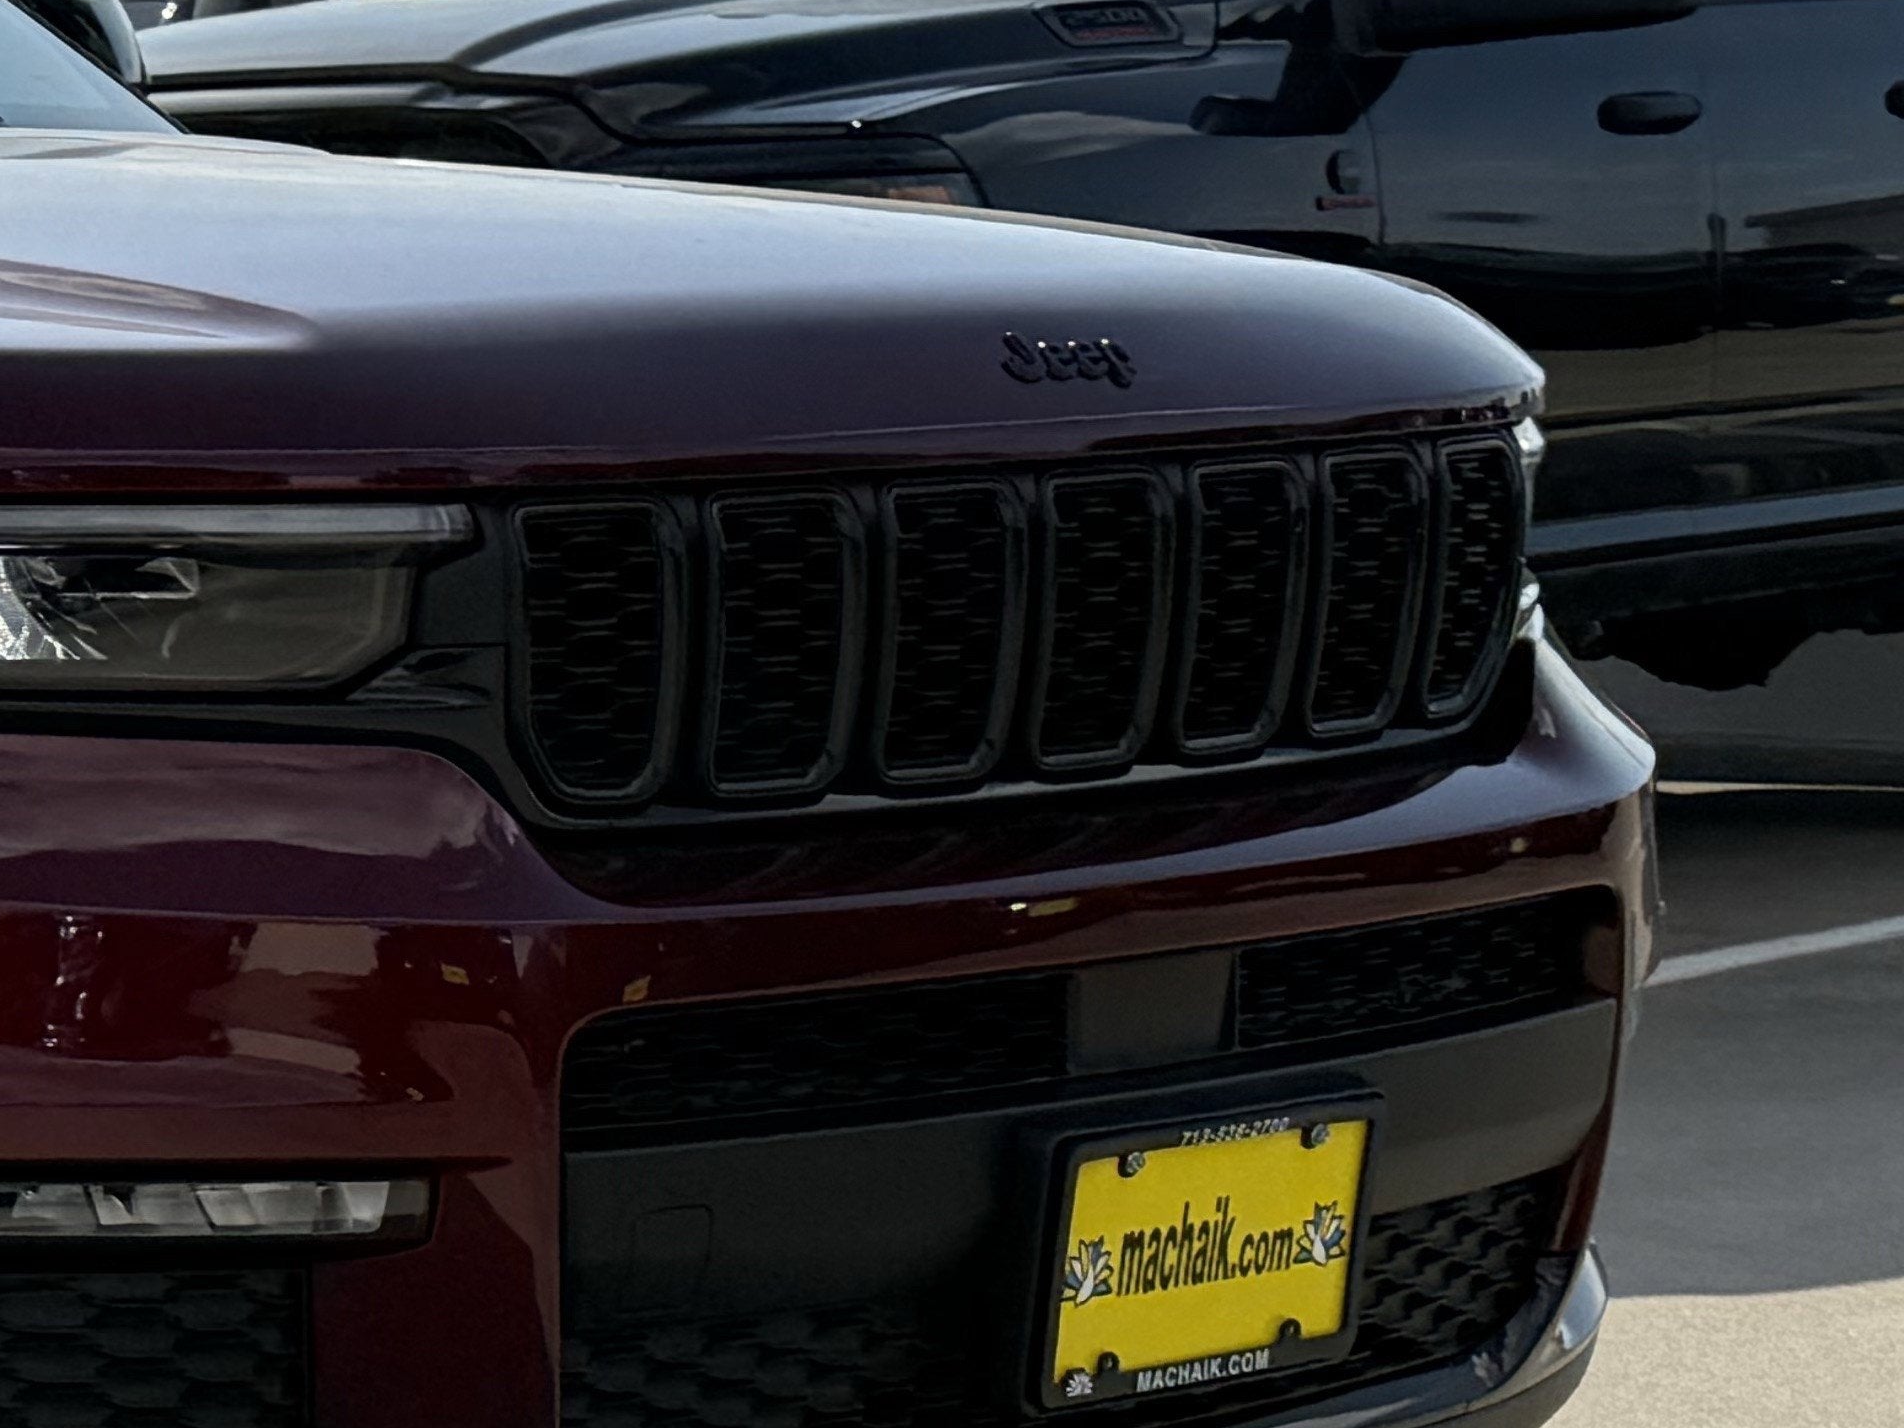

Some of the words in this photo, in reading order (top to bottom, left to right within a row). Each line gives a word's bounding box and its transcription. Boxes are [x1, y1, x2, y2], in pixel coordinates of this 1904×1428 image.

[999, 330, 1138, 390] Jeep
[1115, 1193, 1296, 1298] machaik.com
[1135, 1347, 1271, 1394] MACHAIK.COM
